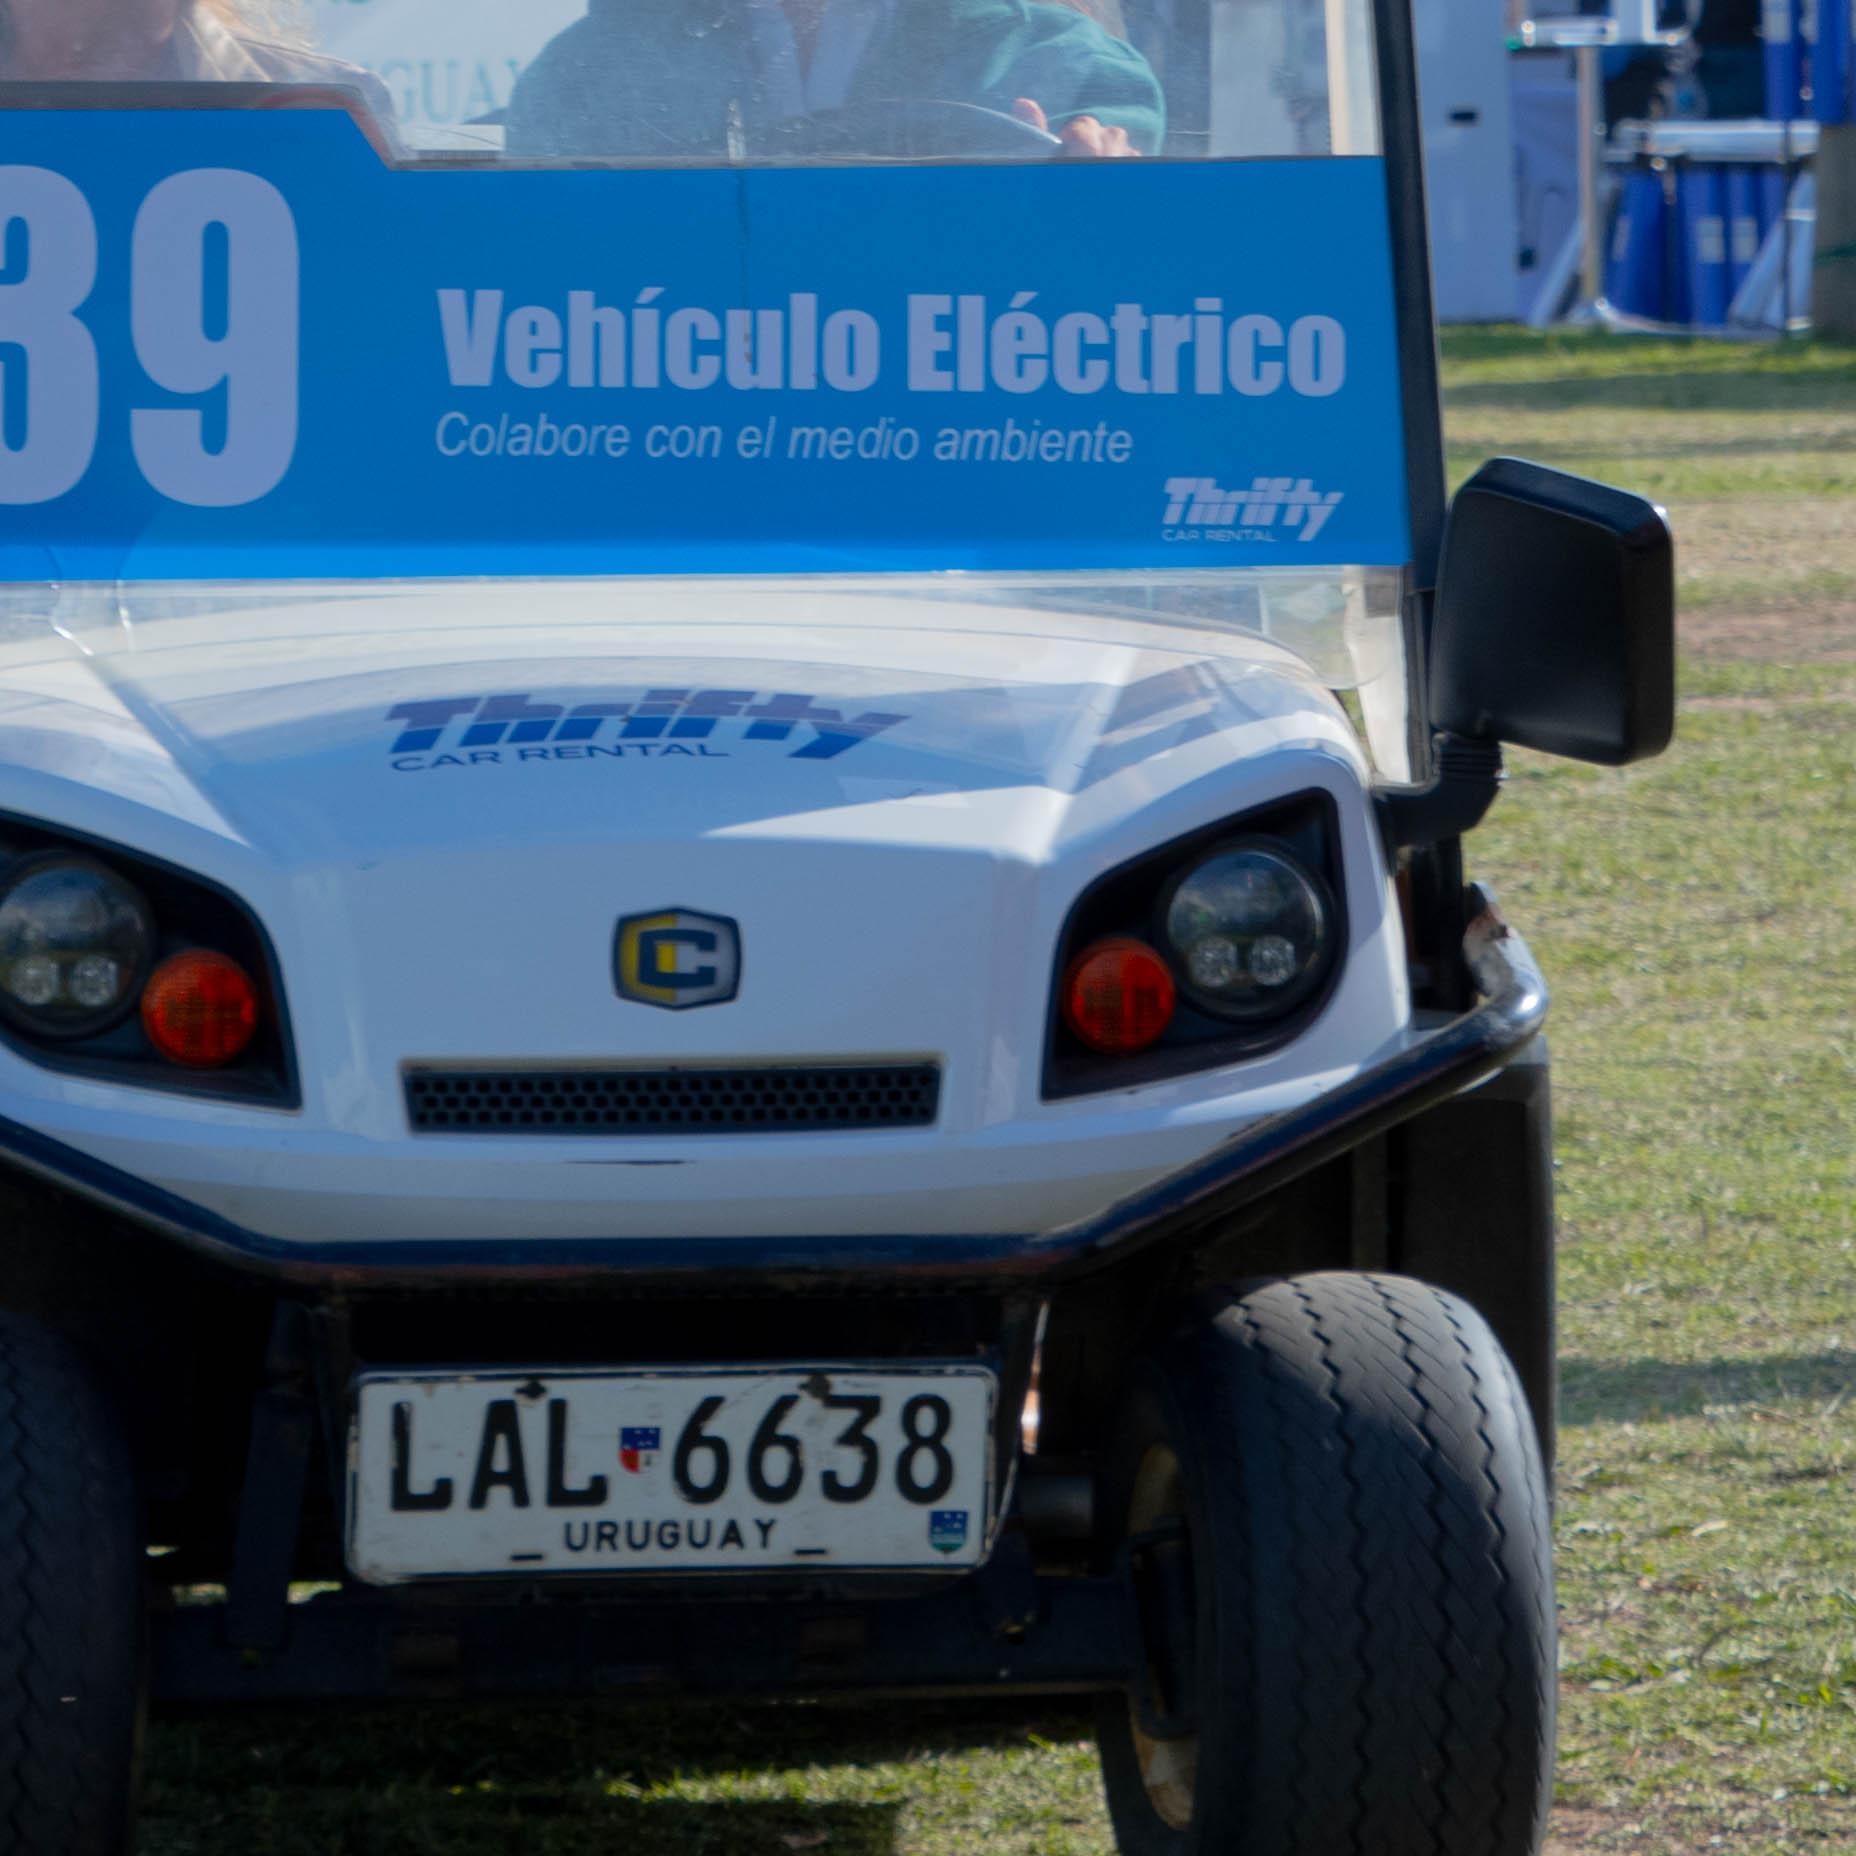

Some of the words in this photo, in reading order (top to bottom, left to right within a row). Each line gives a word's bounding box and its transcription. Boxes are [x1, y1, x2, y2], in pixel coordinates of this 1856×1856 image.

[435, 287, 881, 392] Vehículo
[907, 291, 1345, 397] Eléctrico
[435, 411, 630, 458] Colabore
[645, 423, 722, 460] con
[736, 415, 776, 460] el
[788, 416, 920, 462] medio
[933, 418, 1134, 463] ambiente
[1161, 528, 1200, 542] CAR
[1204, 528, 1278, 542] RENTAL
[1162, 477, 1344, 541] Thrifty
[384, 688, 911, 760] Thrifty
[390, 749, 504, 772] CAR
[517, 743, 731, 763] RENTAL
[390, 1396, 610, 1512] LAL
[671, 1392, 956, 1505] 6638
[562, 1517, 778, 1552] URUGUAY
